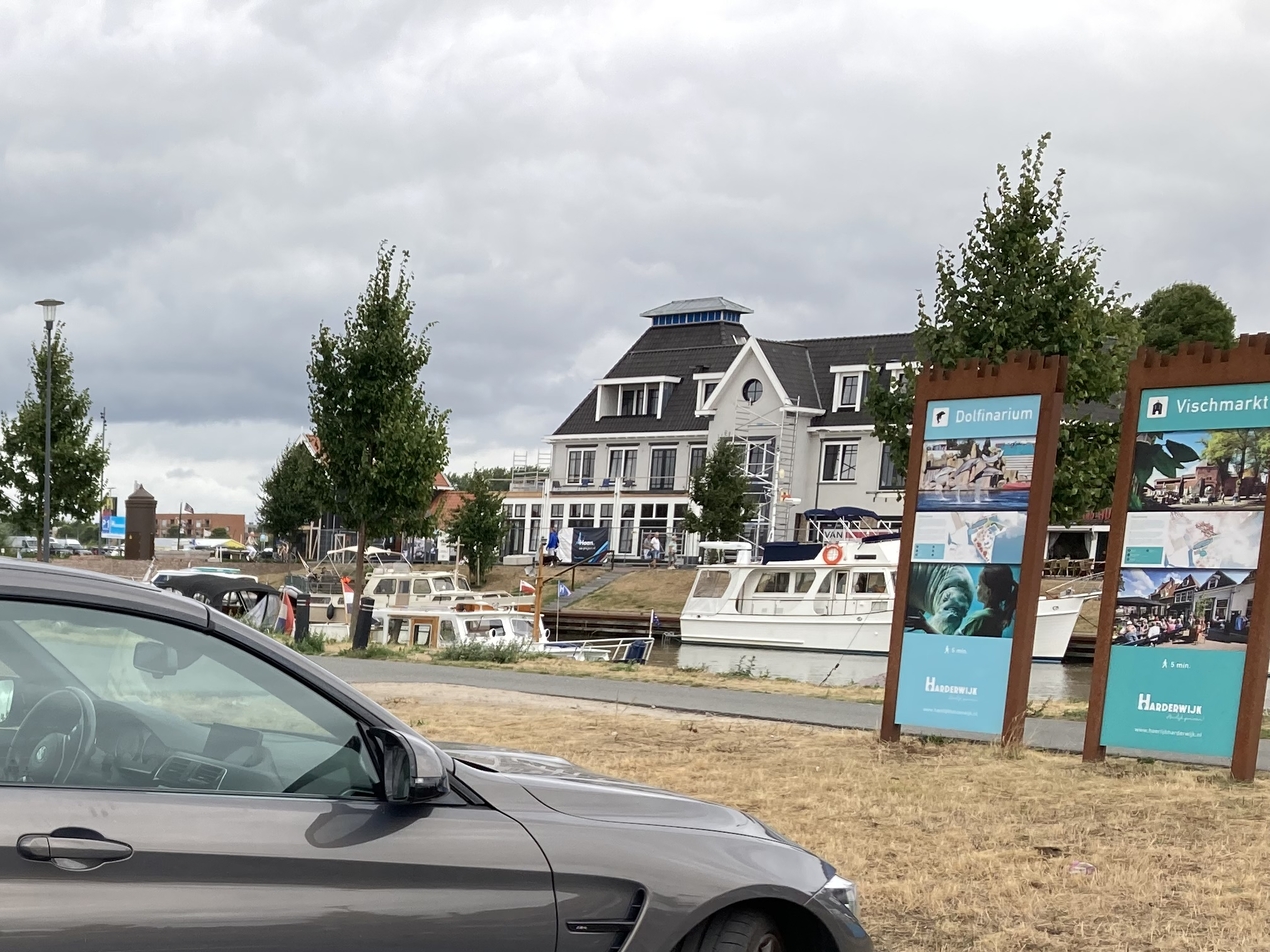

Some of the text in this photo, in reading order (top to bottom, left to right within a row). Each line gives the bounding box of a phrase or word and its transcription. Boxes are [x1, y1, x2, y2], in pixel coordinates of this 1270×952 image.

[1176, 395, 1268, 414] Vischmarkt
[955, 407, 1033, 423] Dolfinarium
[825, 531, 843, 539] VAN
[1137, 693, 1202, 715] HARDERWIJK
